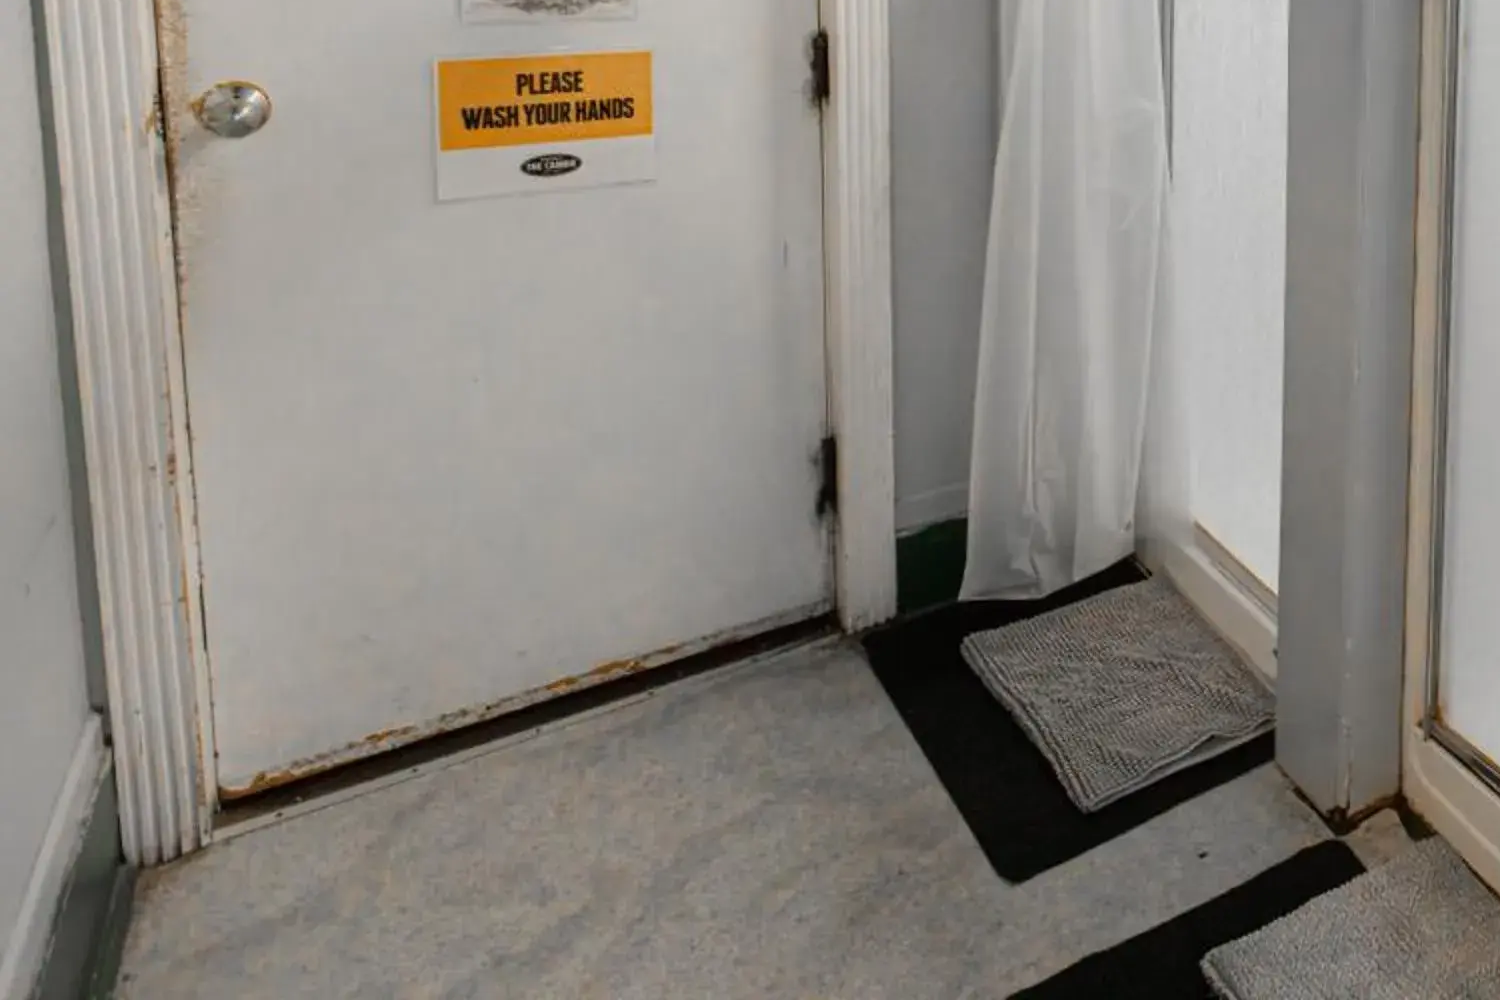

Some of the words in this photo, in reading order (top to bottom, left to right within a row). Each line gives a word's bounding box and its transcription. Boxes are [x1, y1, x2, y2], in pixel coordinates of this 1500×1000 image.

[515, 70, 583, 96] PLEASE
[461, 105, 519, 131] WASH
[524, 101, 571, 126] YOUR
[575, 96, 635, 122] HANDS
